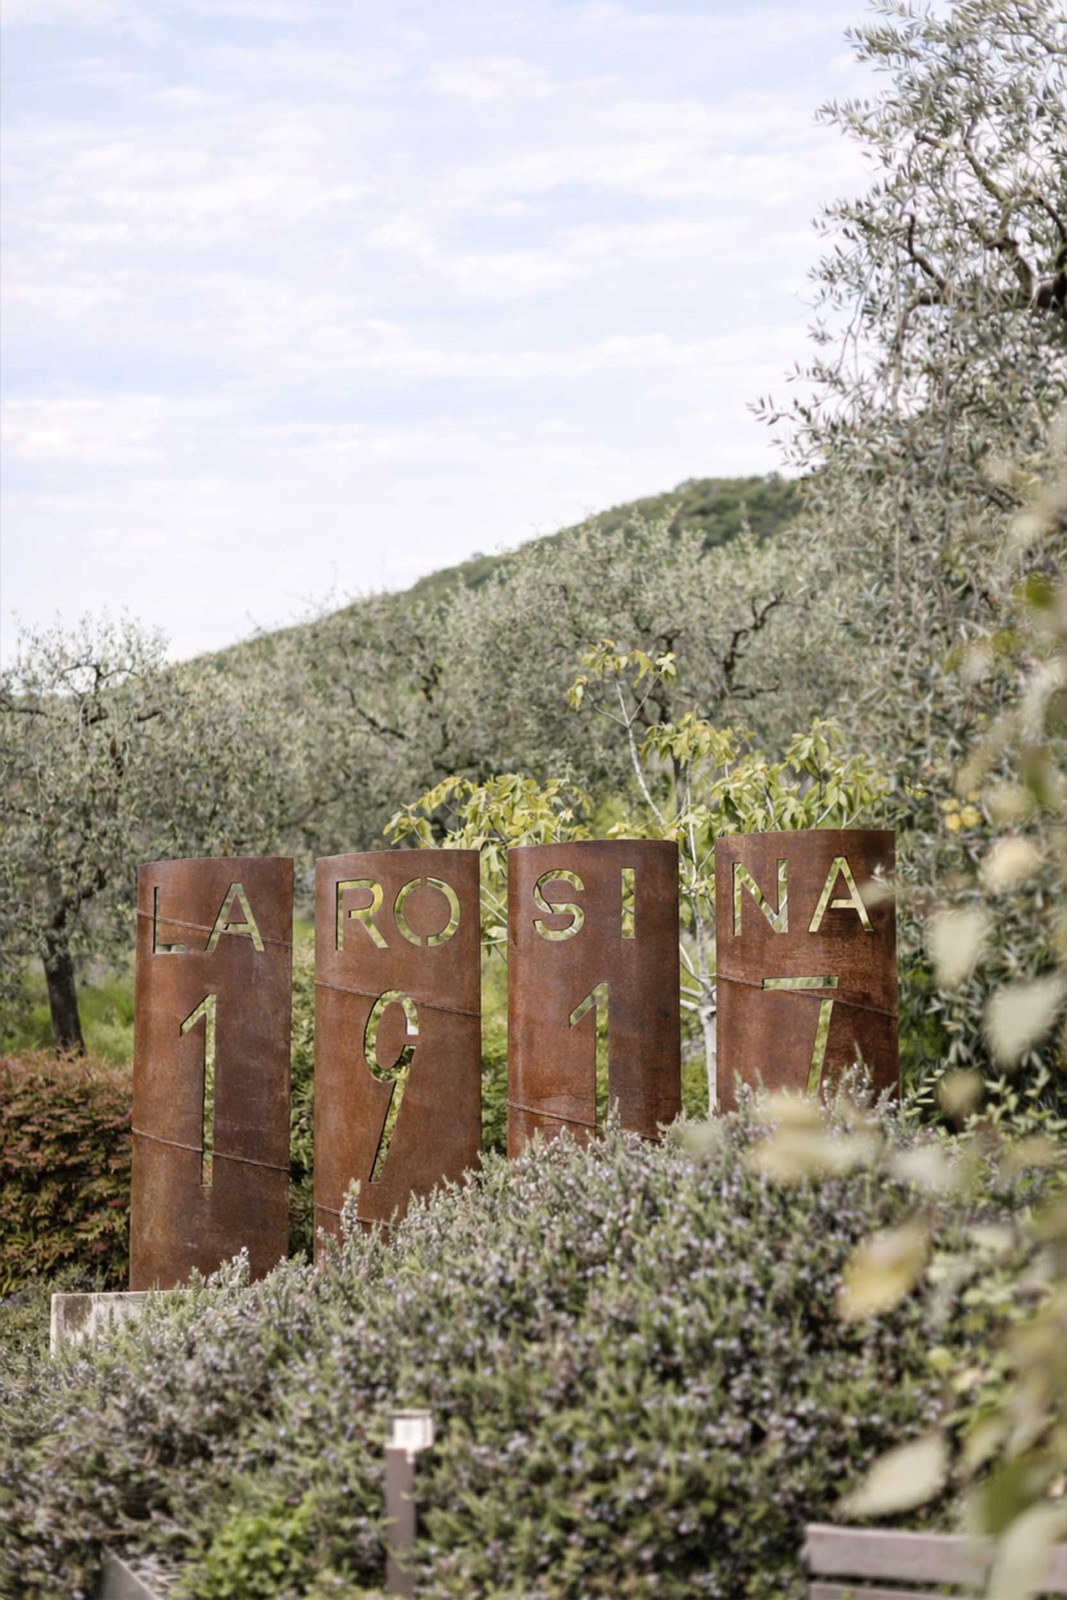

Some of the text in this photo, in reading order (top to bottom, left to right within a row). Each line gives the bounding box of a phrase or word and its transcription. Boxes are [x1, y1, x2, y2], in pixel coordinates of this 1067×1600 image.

[152, 855, 875, 955] LA ROSINA
[179, 975, 839, 1188] 1917
